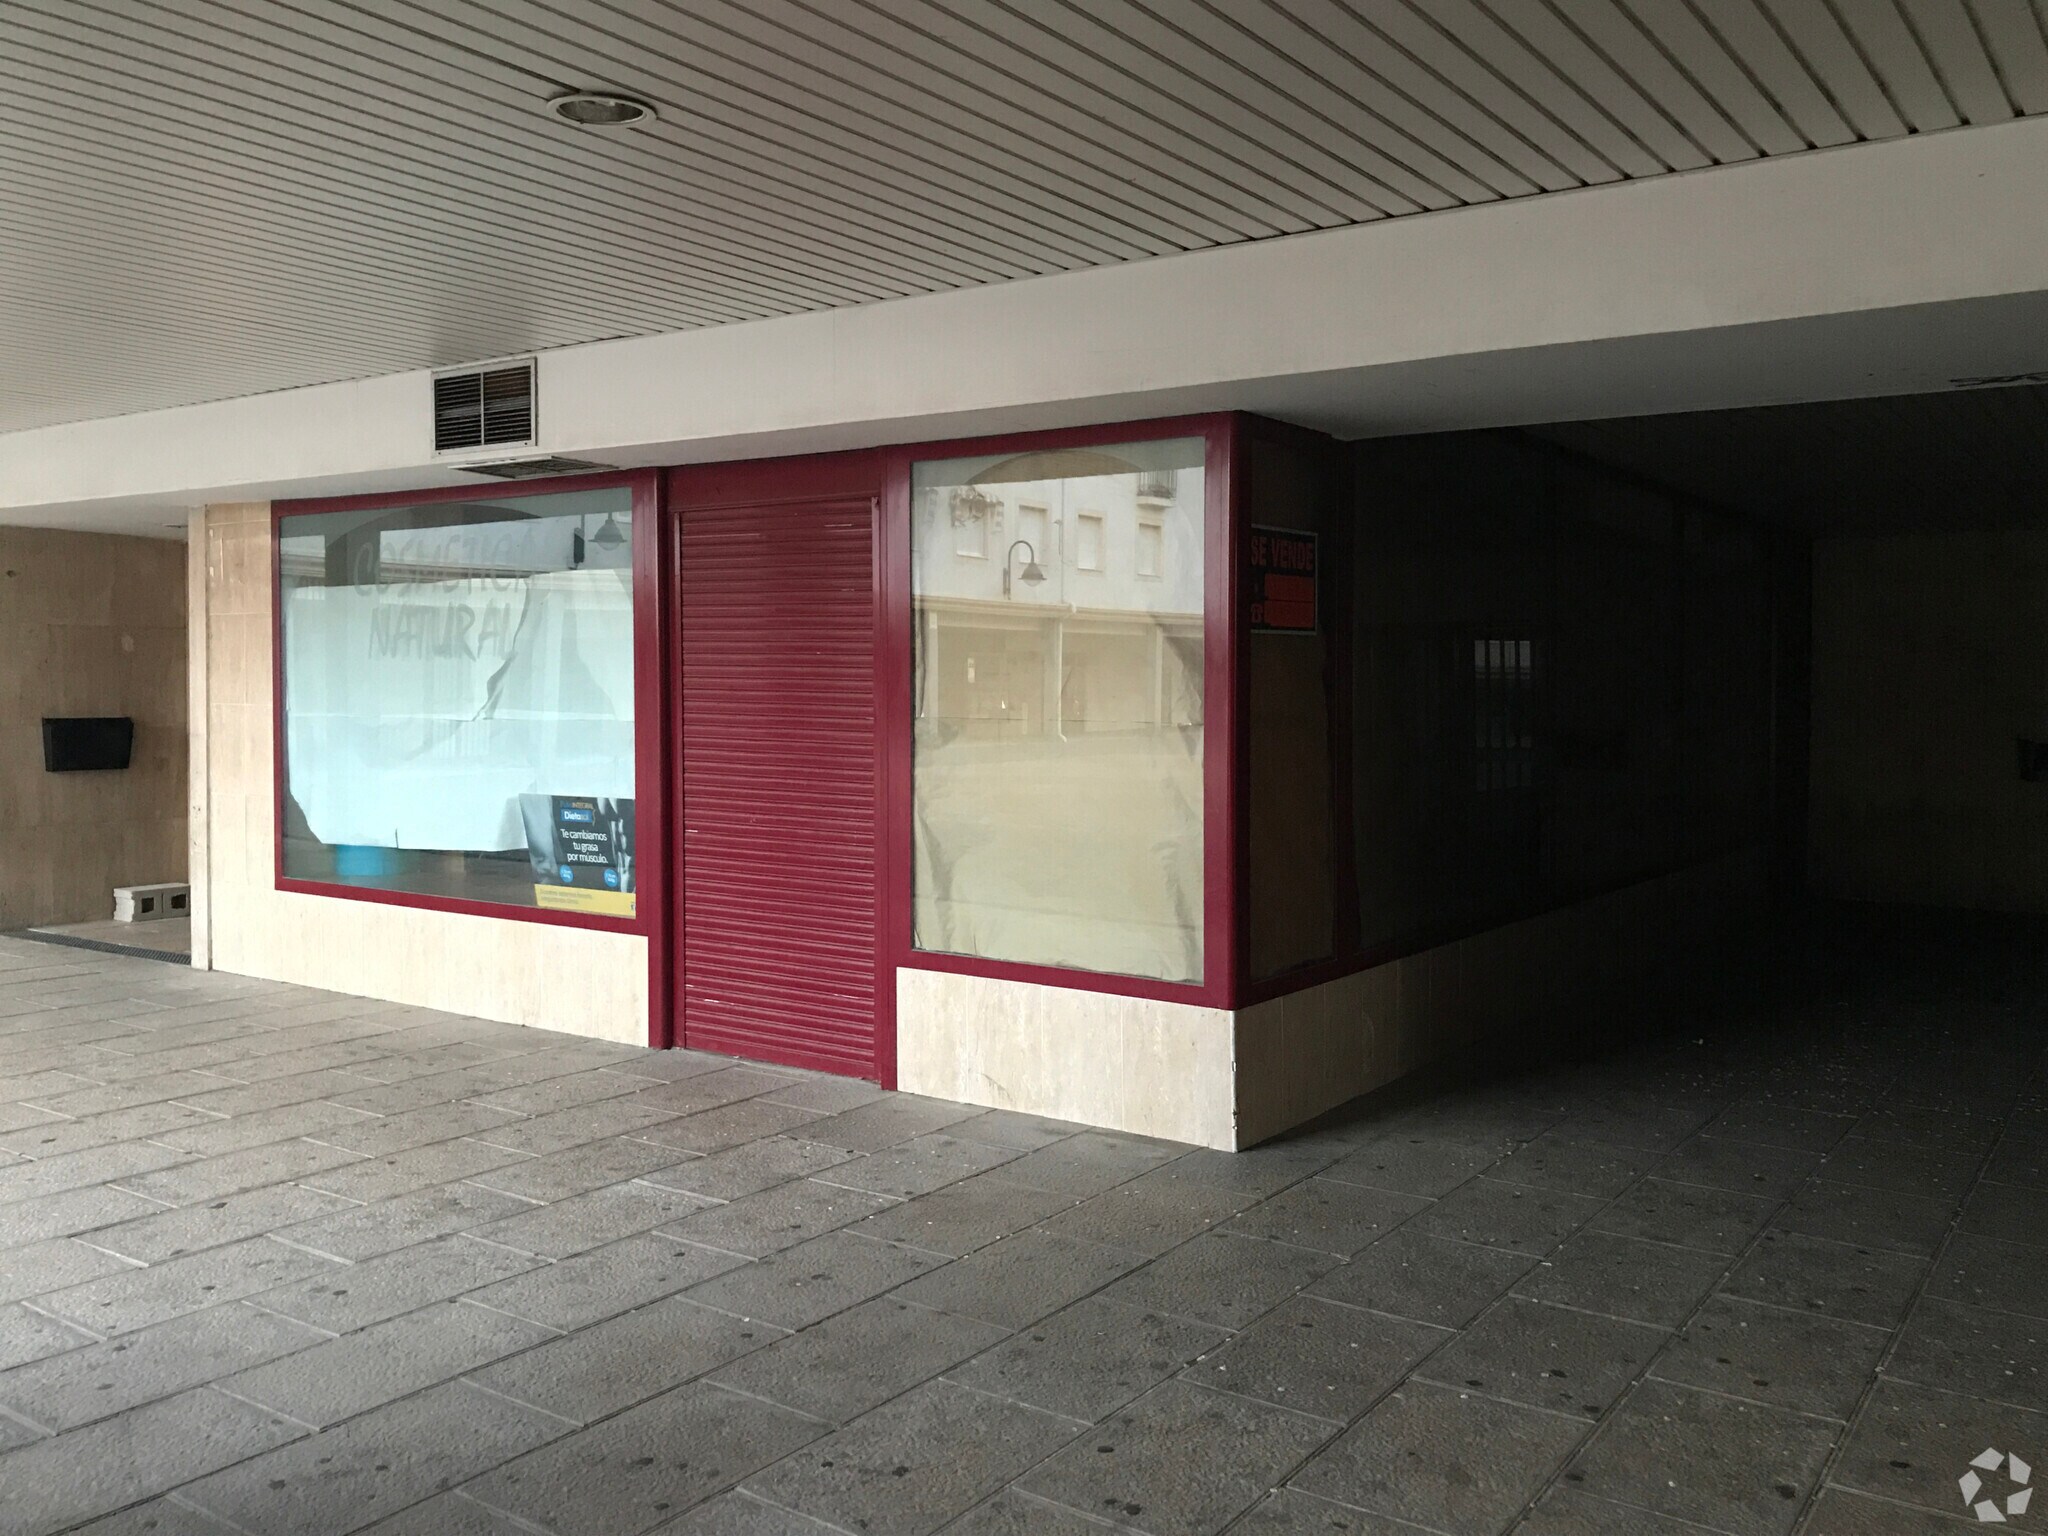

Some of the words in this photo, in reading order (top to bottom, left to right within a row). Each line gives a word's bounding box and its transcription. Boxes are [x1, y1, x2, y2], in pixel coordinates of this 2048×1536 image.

[1251, 536, 1267, 567] SE
[1271, 538, 1315, 571] VENDE
[560, 828, 569, 839] Te
[570, 829, 607, 841] cambiamos
[573, 842, 581, 850] tu
[582, 843, 598, 853] grasa
[567, 853, 579, 863] por
